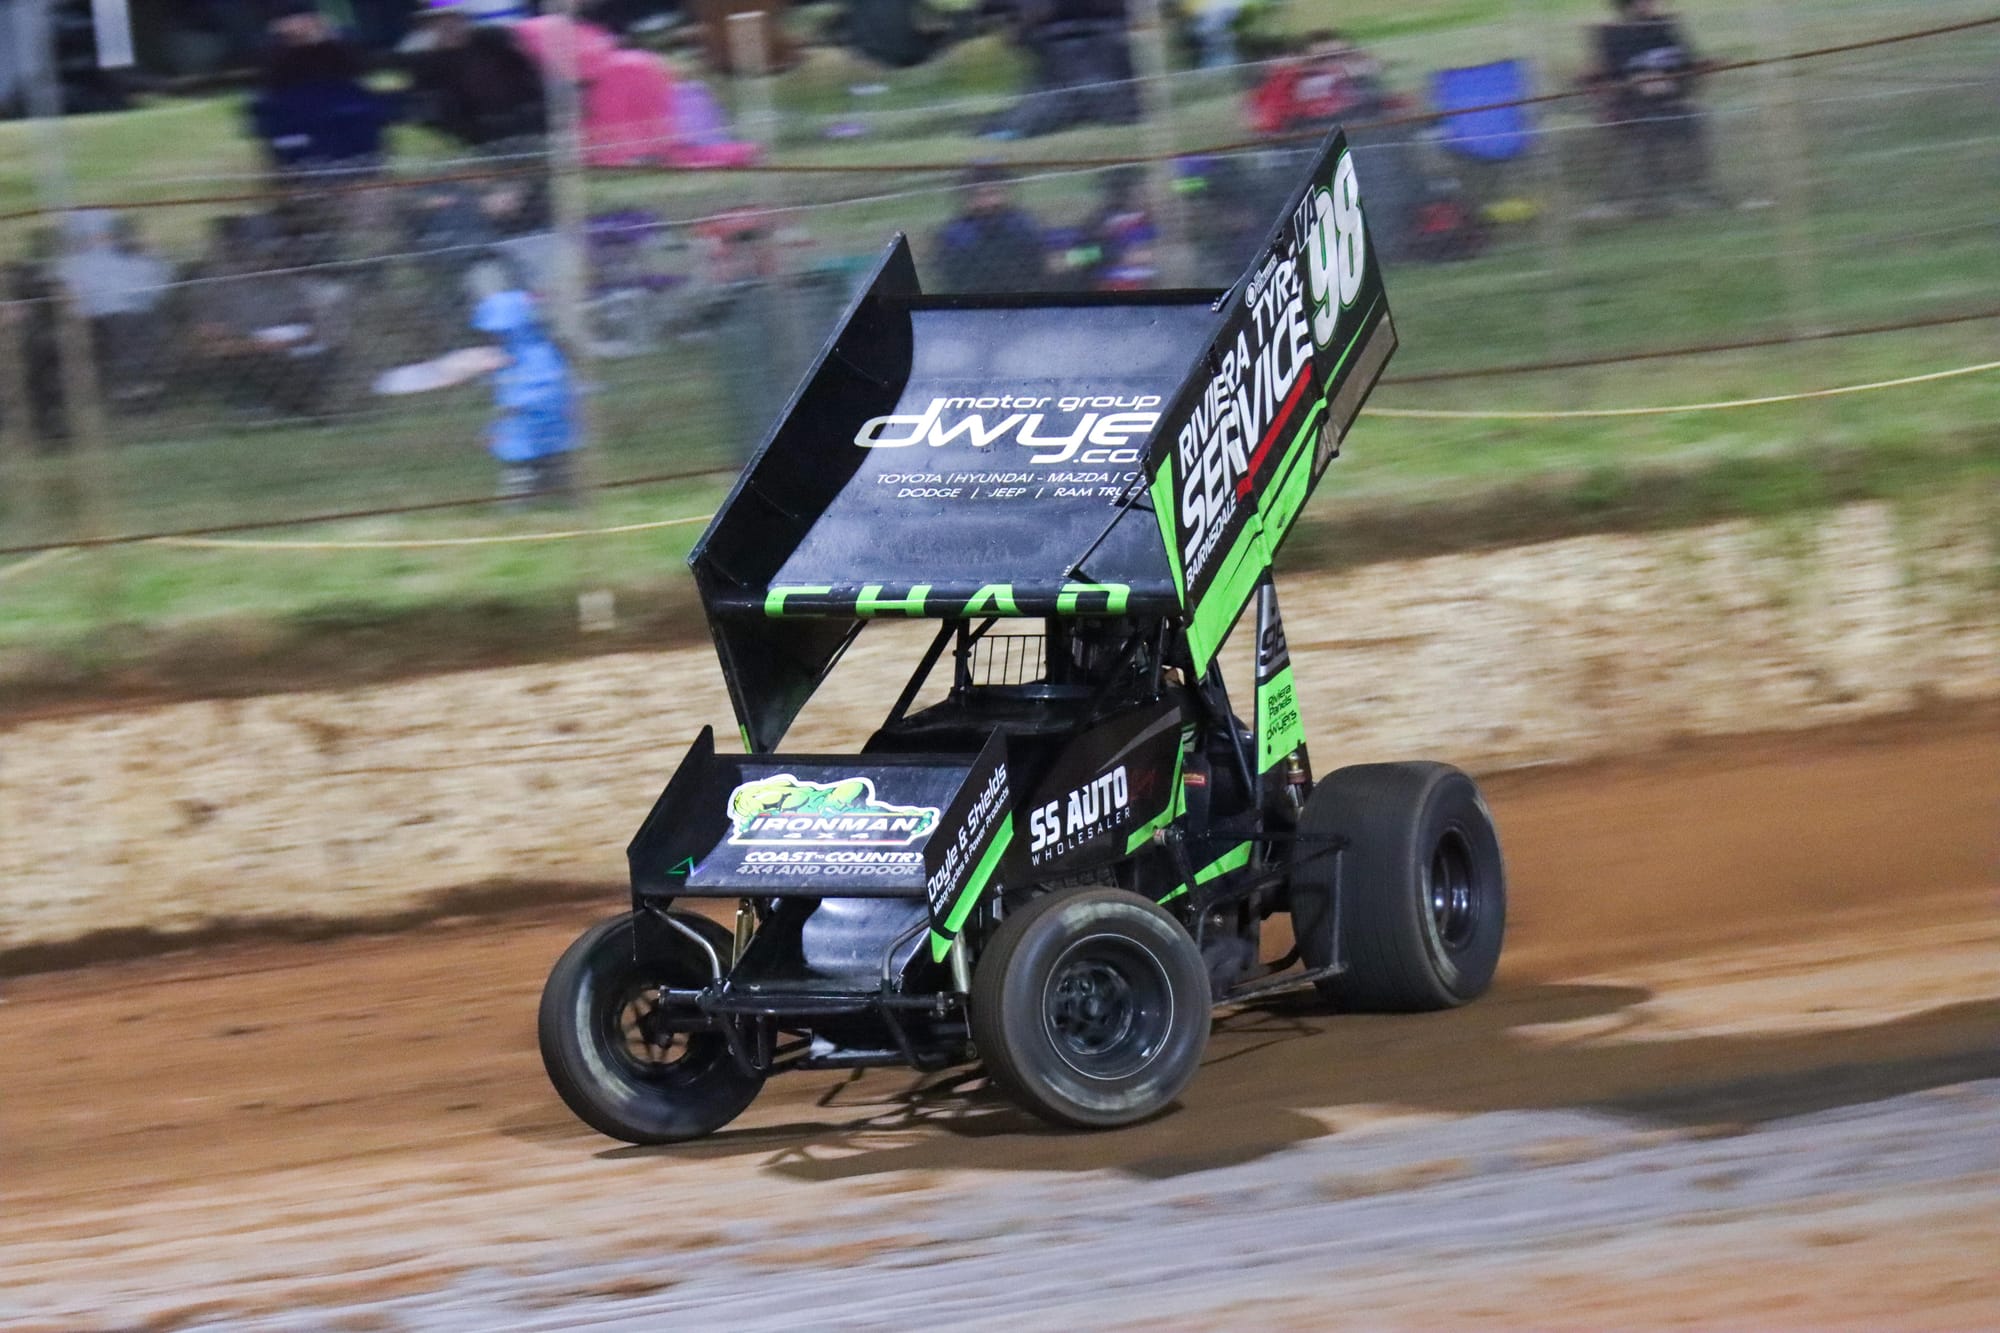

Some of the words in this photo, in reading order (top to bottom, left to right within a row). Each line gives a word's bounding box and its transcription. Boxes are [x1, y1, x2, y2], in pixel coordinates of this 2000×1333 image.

[1308, 149, 1366, 347] 98
[944, 395, 1052, 409] motor
[1057, 395, 1161, 412] group
[1178, 330, 1251, 480] RIVIERA
[1182, 279, 1314, 566] SERVICE
[877, 473, 942, 484] TOYOTA
[1047, 472, 1109, 483] MAZDA
[897, 487, 962, 498] DODGE
[988, 487, 1027, 497] JEEP
[1053, 487, 1093, 497] RAM
[1186, 489, 1237, 591] BAIRNSDALE
[750, 817, 921, 832] IRONMAN
[927, 844, 959, 903] Doyle
[958, 826, 968, 851] &
[967, 763, 1007, 836] Shields
[1030, 800, 1061, 853] SS
[1066, 765, 1128, 836] AUTO
[1031, 806, 1130, 866] WHOLESALER
[736, 864, 775, 875] 4X4
[776, 864, 819, 875] AND
[823, 864, 920, 875] OUTDOOR
[745, 851, 815, 863] COAST
[824, 851, 924, 863] COUNTRY
[933, 860, 965, 917] Motorcycles
[968, 825, 986, 857] Power
[985, 786, 1010, 829] Products
